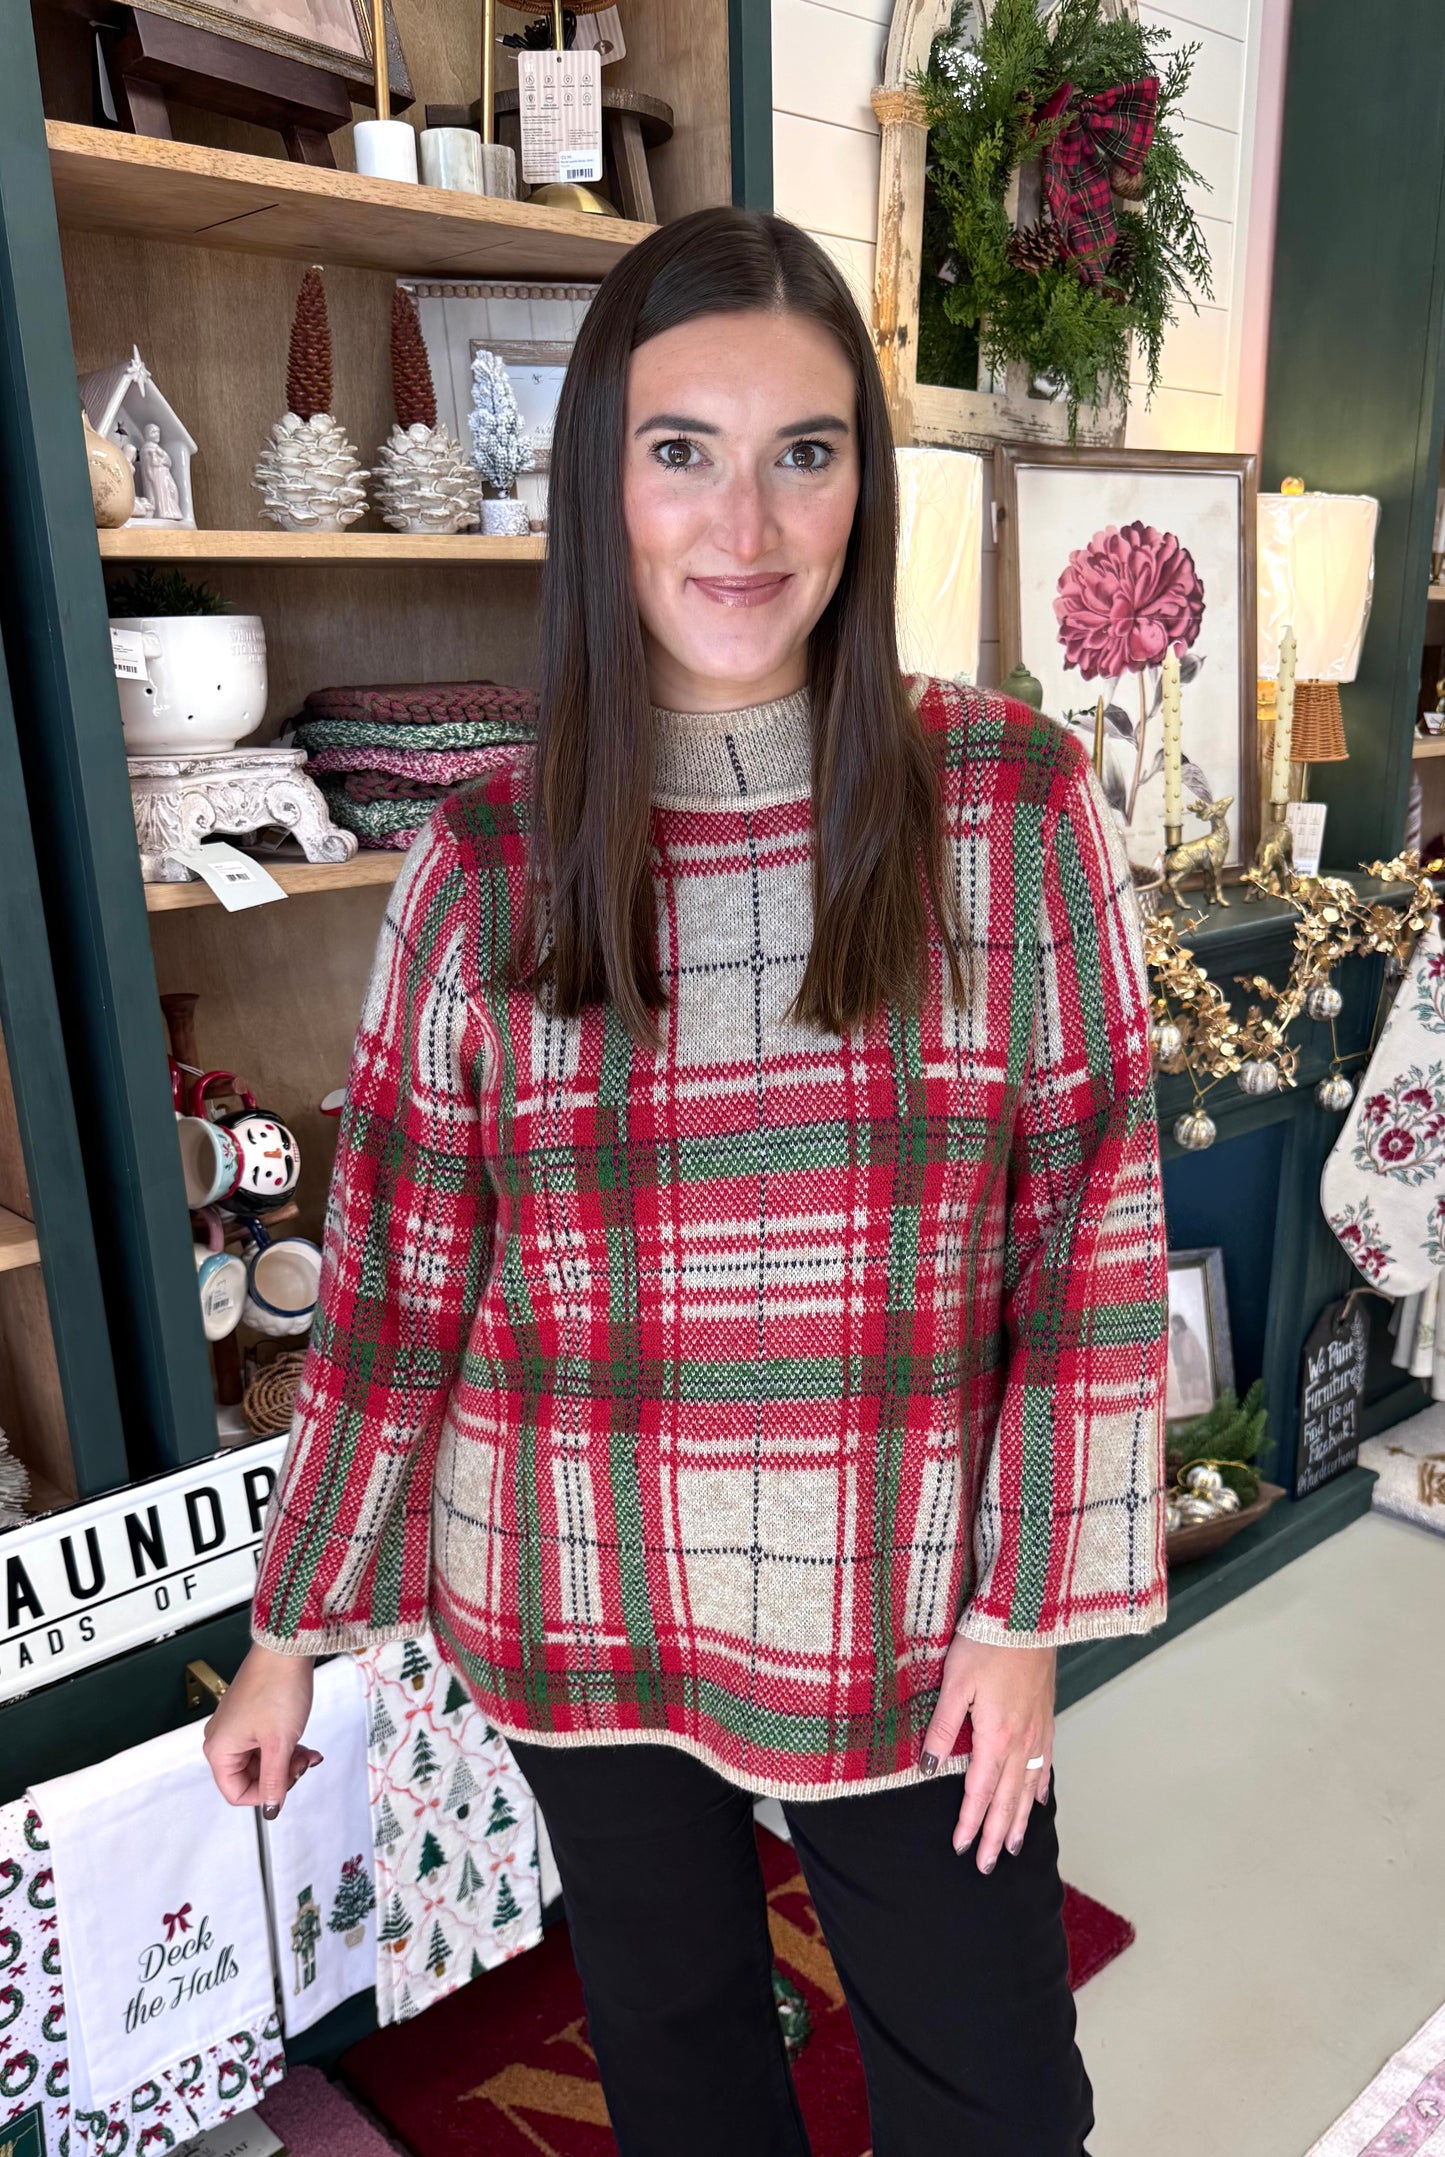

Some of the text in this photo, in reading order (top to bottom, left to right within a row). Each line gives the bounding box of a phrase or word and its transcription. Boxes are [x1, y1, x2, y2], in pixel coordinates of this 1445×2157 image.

[1308, 1336, 1354, 1382] We Paint
[1304, 1367, 1358, 1419] Furniture
[1303, 1413, 1325, 1447] Find
[0, 1574, 198, 1677] ADS OF
[138, 1914, 214, 1983] Deck
[122, 1943, 240, 2035] the Halls
